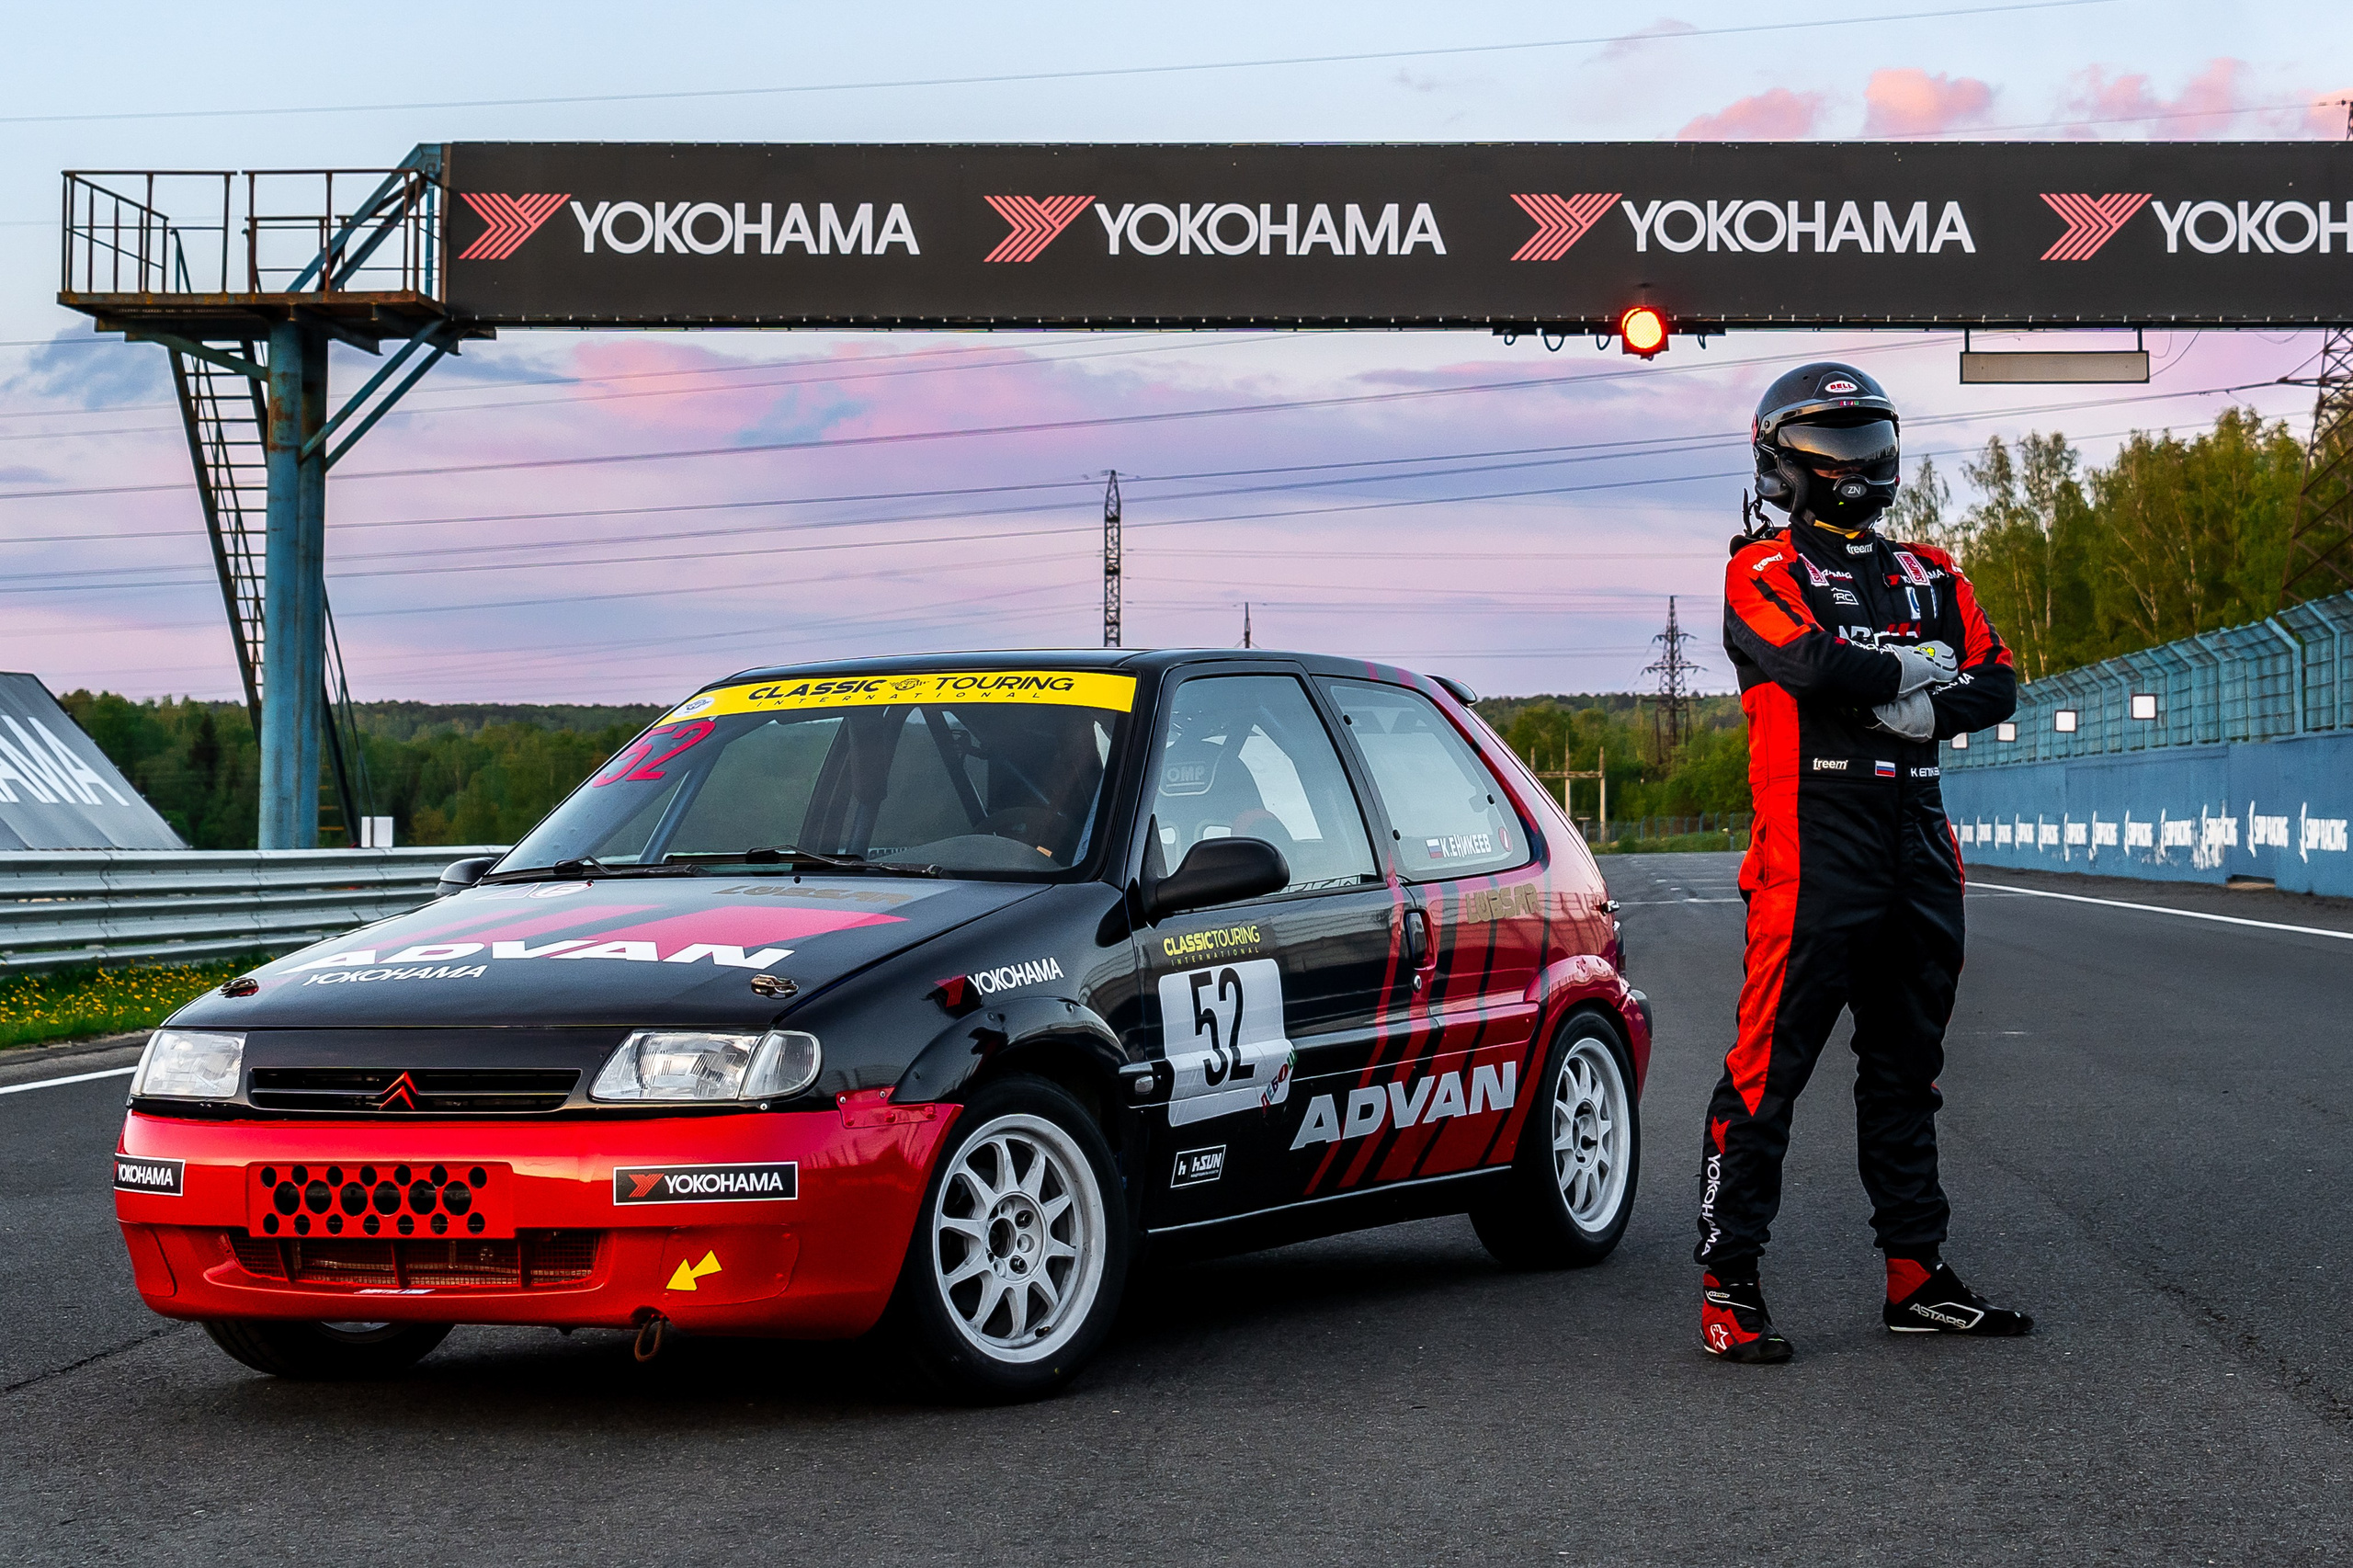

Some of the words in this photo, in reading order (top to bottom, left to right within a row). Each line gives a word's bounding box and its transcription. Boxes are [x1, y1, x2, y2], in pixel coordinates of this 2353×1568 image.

[569, 201, 920, 256] YOKOHAMA
[1094, 202, 1448, 256] YOKOHAMA
[1620, 199, 1977, 254] YOKOHAMA
[2151, 199, 2353, 254] YOKOH
[1846, 542, 1873, 555] freem
[747, 678, 887, 700] CLASSIC
[936, 676, 1075, 692] TOURING
[756, 691, 1040, 707] INTERNATIONAL
[592, 721, 715, 789] 52
[1166, 765, 1206, 782] OMP
[1813, 757, 1849, 770] freem
[1464, 882, 1542, 925] LUBSAR
[274, 939, 796, 976] ADVAN
[302, 964, 488, 986] YOKOHAMA
[1170, 946, 1259, 967] INTERNATIONAL
[967, 957, 1064, 995] YOKOHAMA
[1188, 967, 1256, 1087] 52
[1289, 1060, 1518, 1151] ADVAN
[118, 1163, 174, 1187] YOKOHAMA
[664, 1172, 784, 1194] YOKOHAMA
[1701, 1153, 1722, 1256] YOKOHAMA
